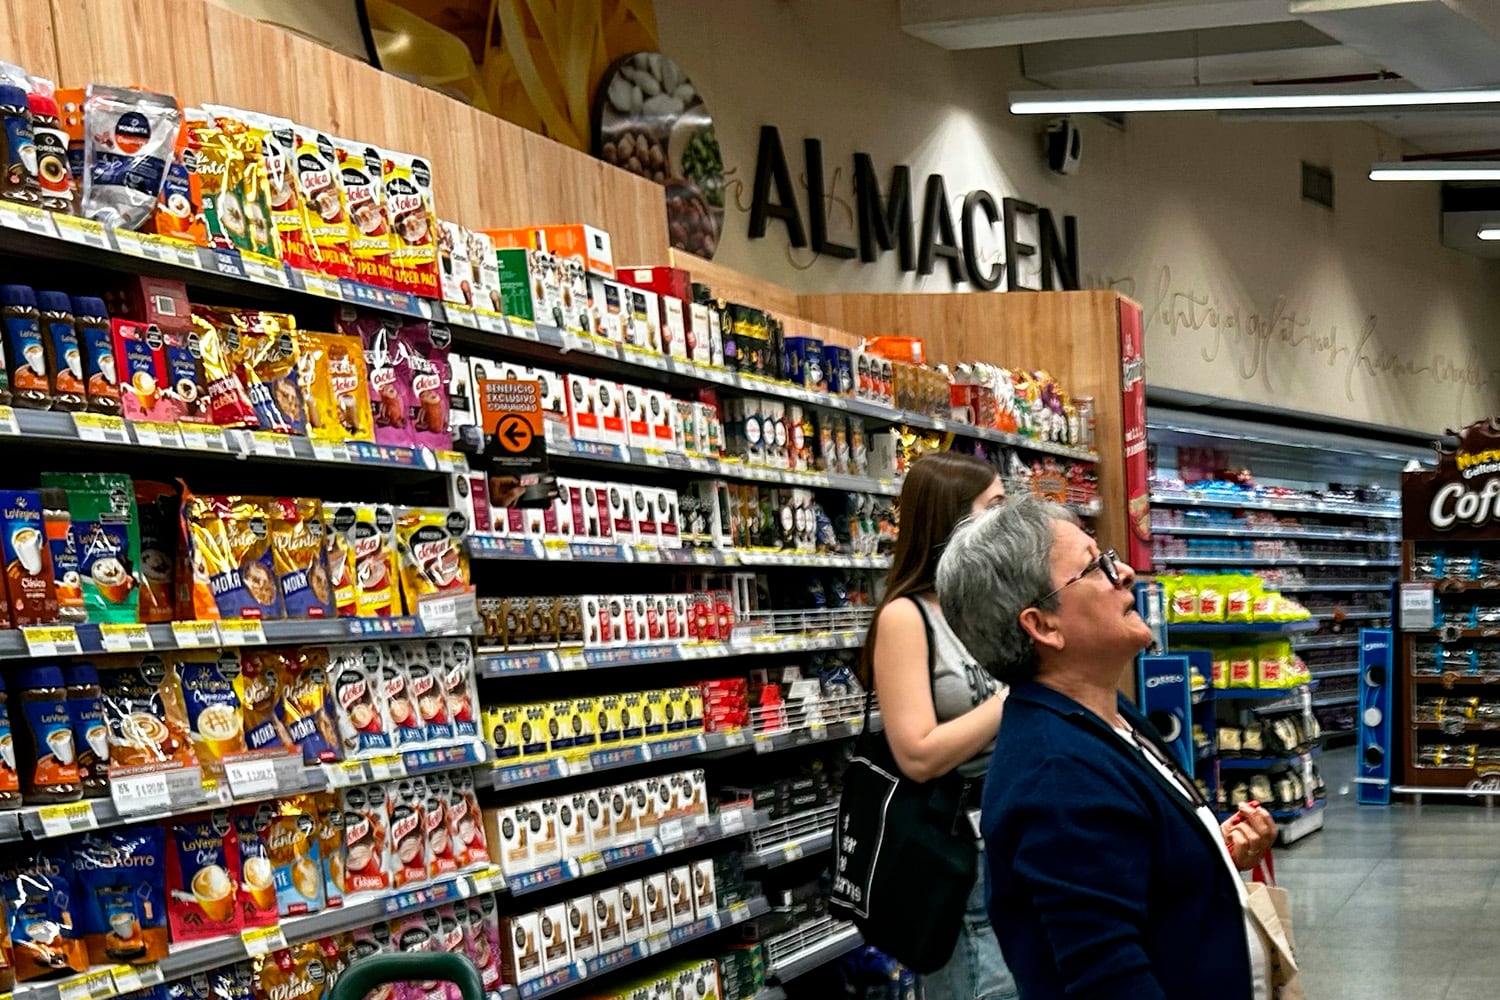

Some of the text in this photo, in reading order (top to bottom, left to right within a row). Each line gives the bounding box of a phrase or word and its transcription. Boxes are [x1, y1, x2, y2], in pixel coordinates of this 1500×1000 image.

[305, 171, 329, 188] dolca
[396, 196, 419, 211] olca
[747, 125, 1080, 293] ALMACEN
[357, 261, 379, 276] UPER
[485, 383, 536, 394] BENEFICIO
[486, 393, 537, 403] EXCLUSIVO
[487, 402, 538, 412] COMUNIDAD
[211, 573, 242, 595] MOKA
[282, 574, 307, 595] MOKA
[251, 722, 276, 747] MOKA
[290, 718, 317, 743] MOKA
[268, 834, 301, 851] lanta
